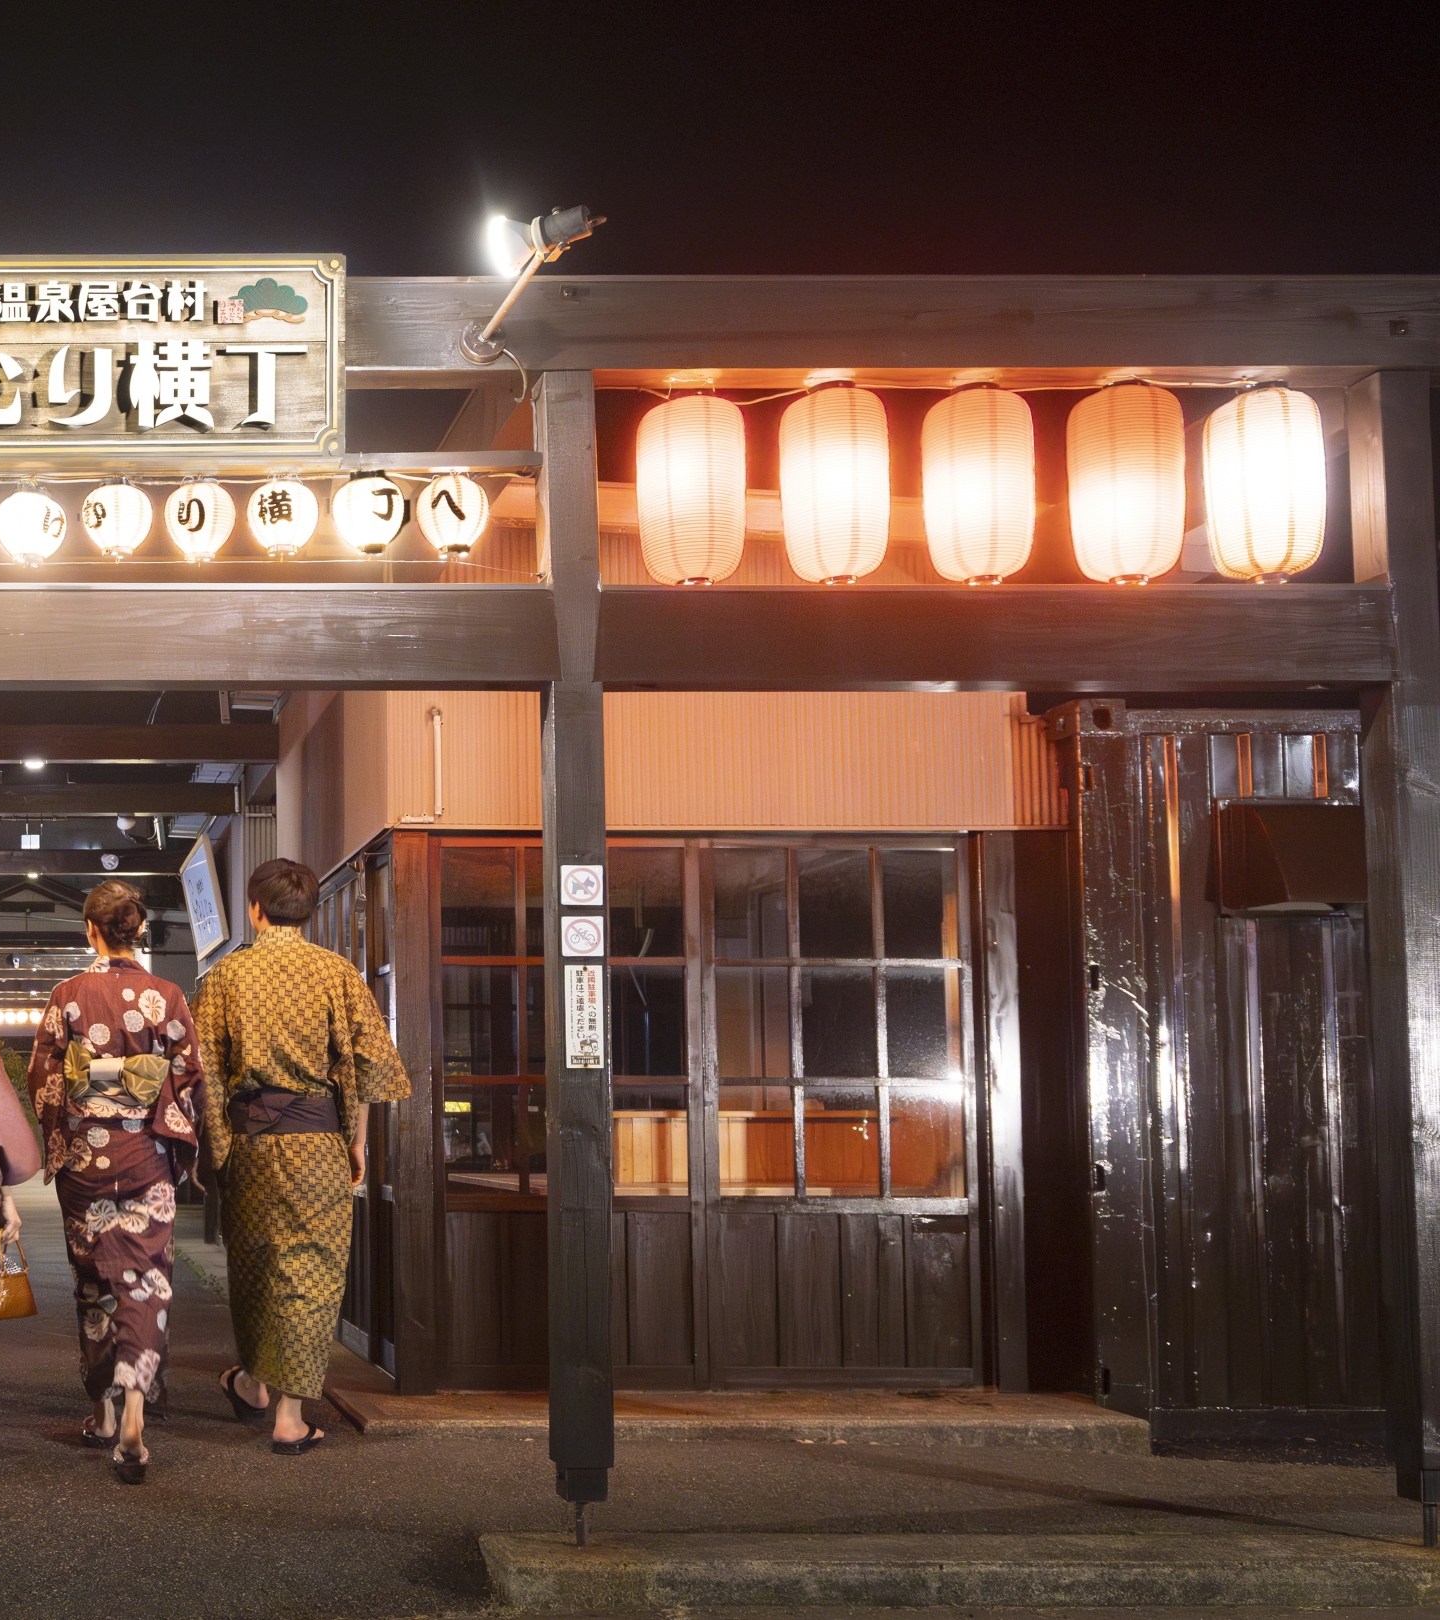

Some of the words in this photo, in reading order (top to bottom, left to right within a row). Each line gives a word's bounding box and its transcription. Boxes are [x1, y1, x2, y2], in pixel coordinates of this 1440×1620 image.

[575, 970, 586, 1039] 駐車はご遠慮ください
[587, 970, 597, 1032] 近隣駐車場への無断
